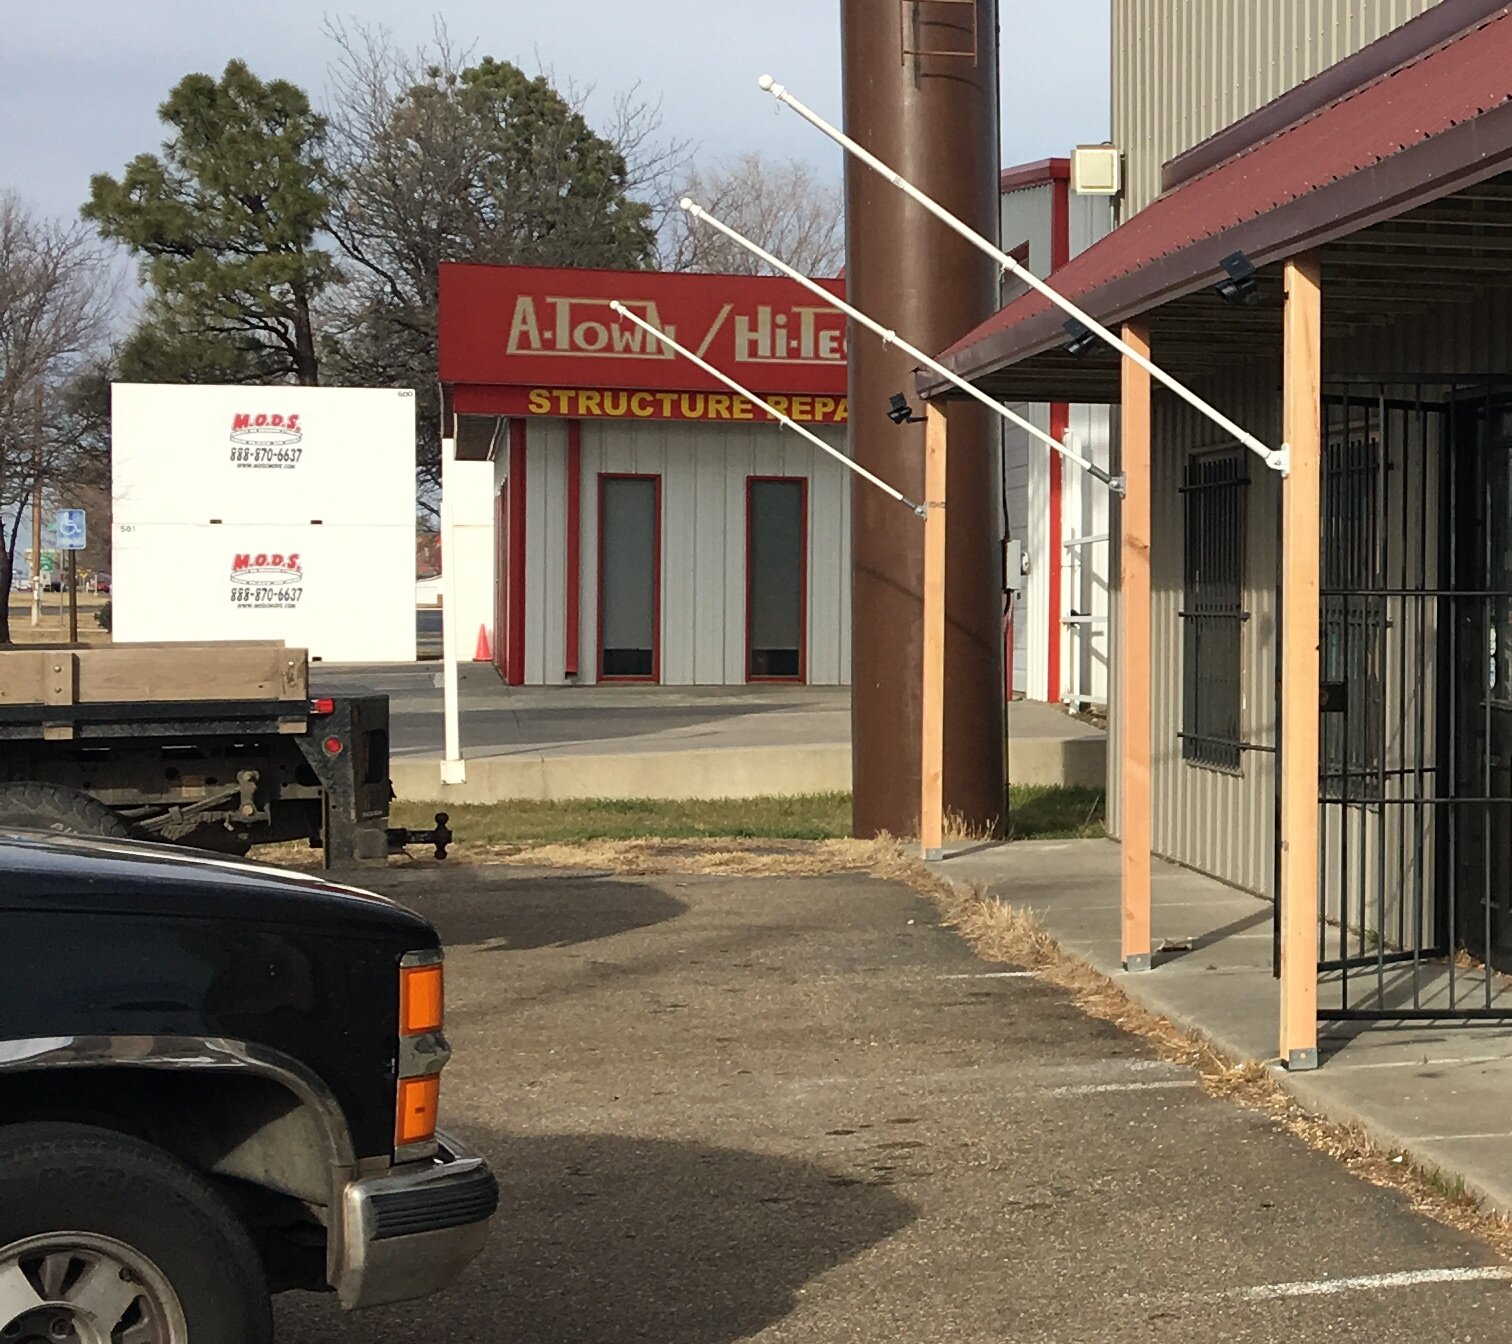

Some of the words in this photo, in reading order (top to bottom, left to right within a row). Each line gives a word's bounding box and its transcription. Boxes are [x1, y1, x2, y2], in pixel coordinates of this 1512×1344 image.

[528, 389, 753, 419] STRUCTURE
[230, 447, 302, 462] 888-870-6637
[230, 587, 303, 602] 888-870-6637
